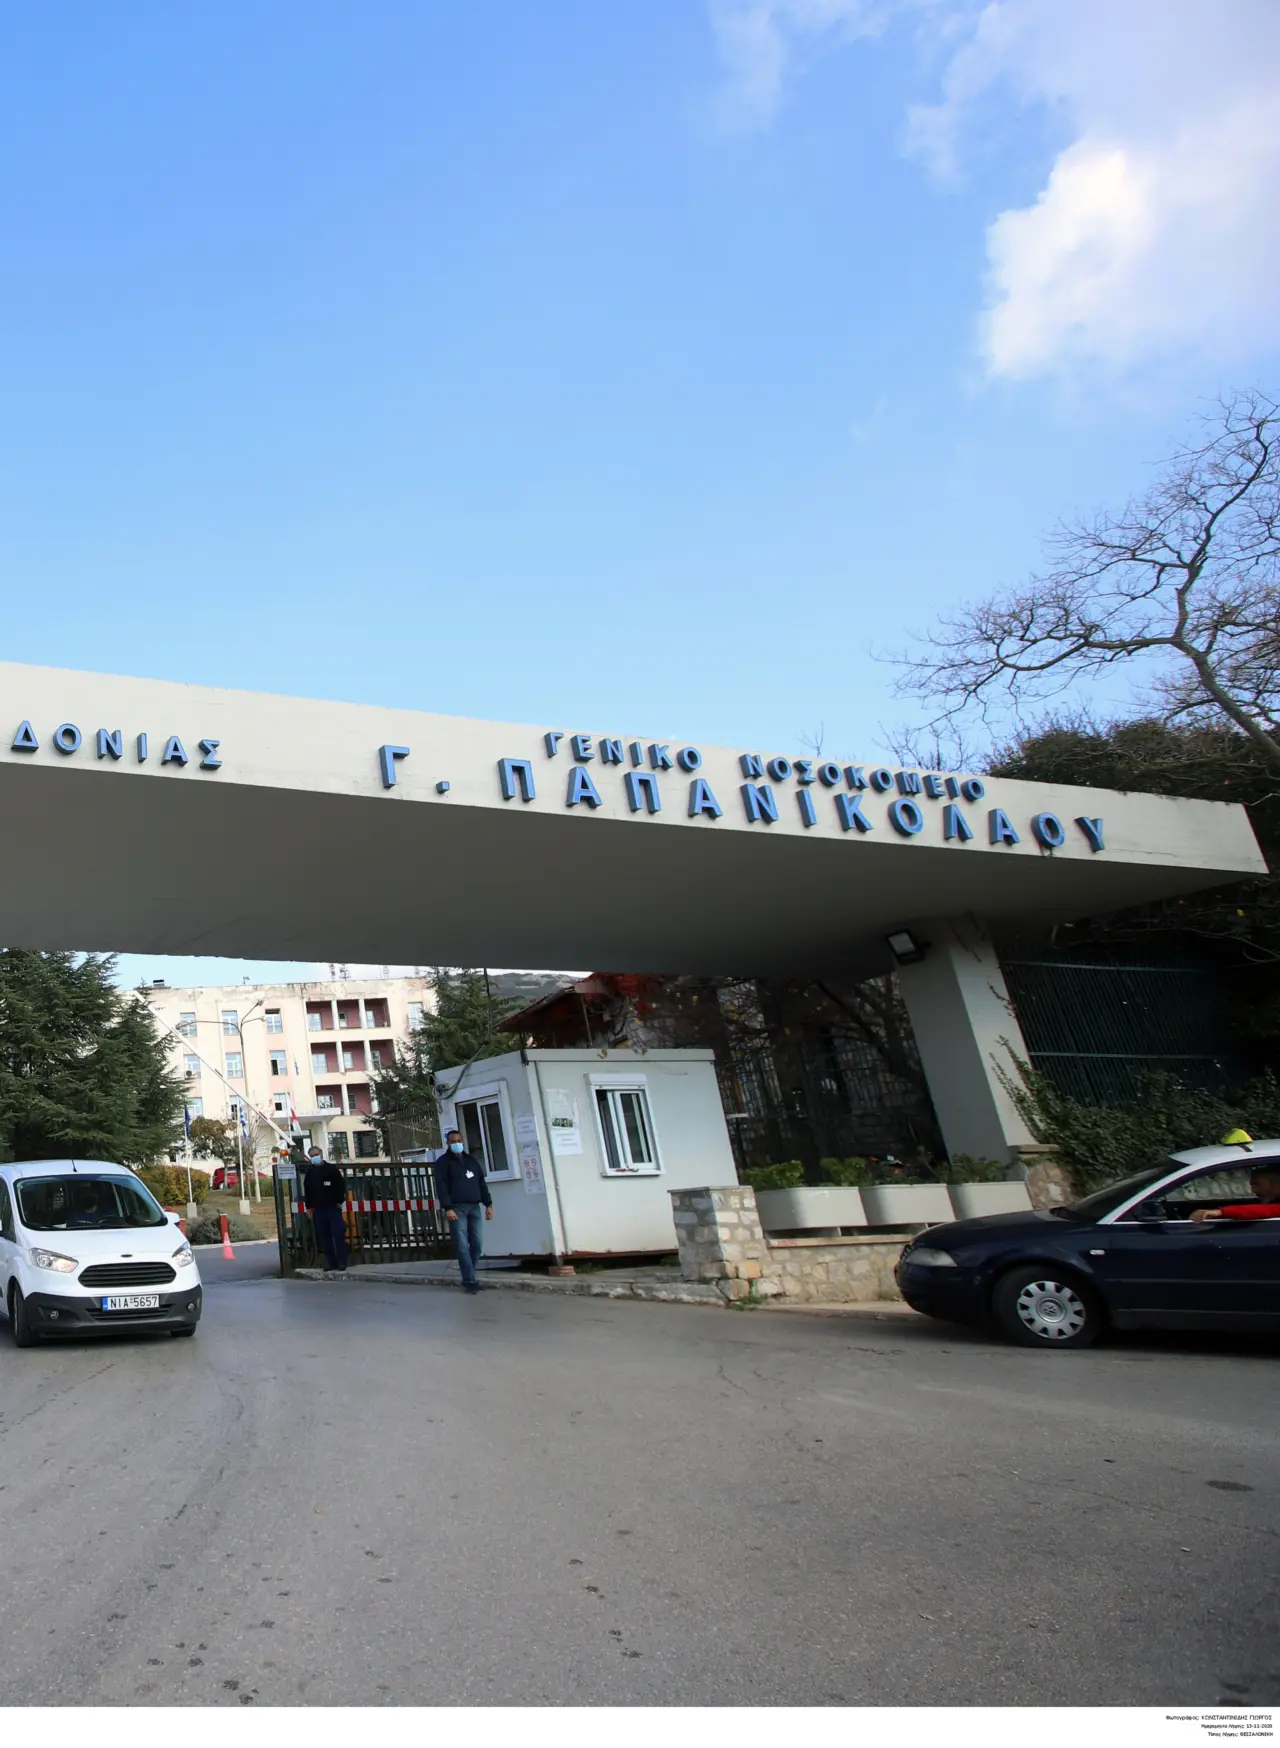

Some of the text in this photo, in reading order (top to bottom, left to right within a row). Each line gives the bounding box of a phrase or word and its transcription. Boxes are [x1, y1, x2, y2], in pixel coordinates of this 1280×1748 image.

[379, 745, 1106, 853] Γ. ΠΑΠΑΝΙΚΟΛΑΟΥ
[543, 732, 986, 801] ΓΕΝΙΚΟ ΝΟΣΟΚΟΜΕΙΟ
